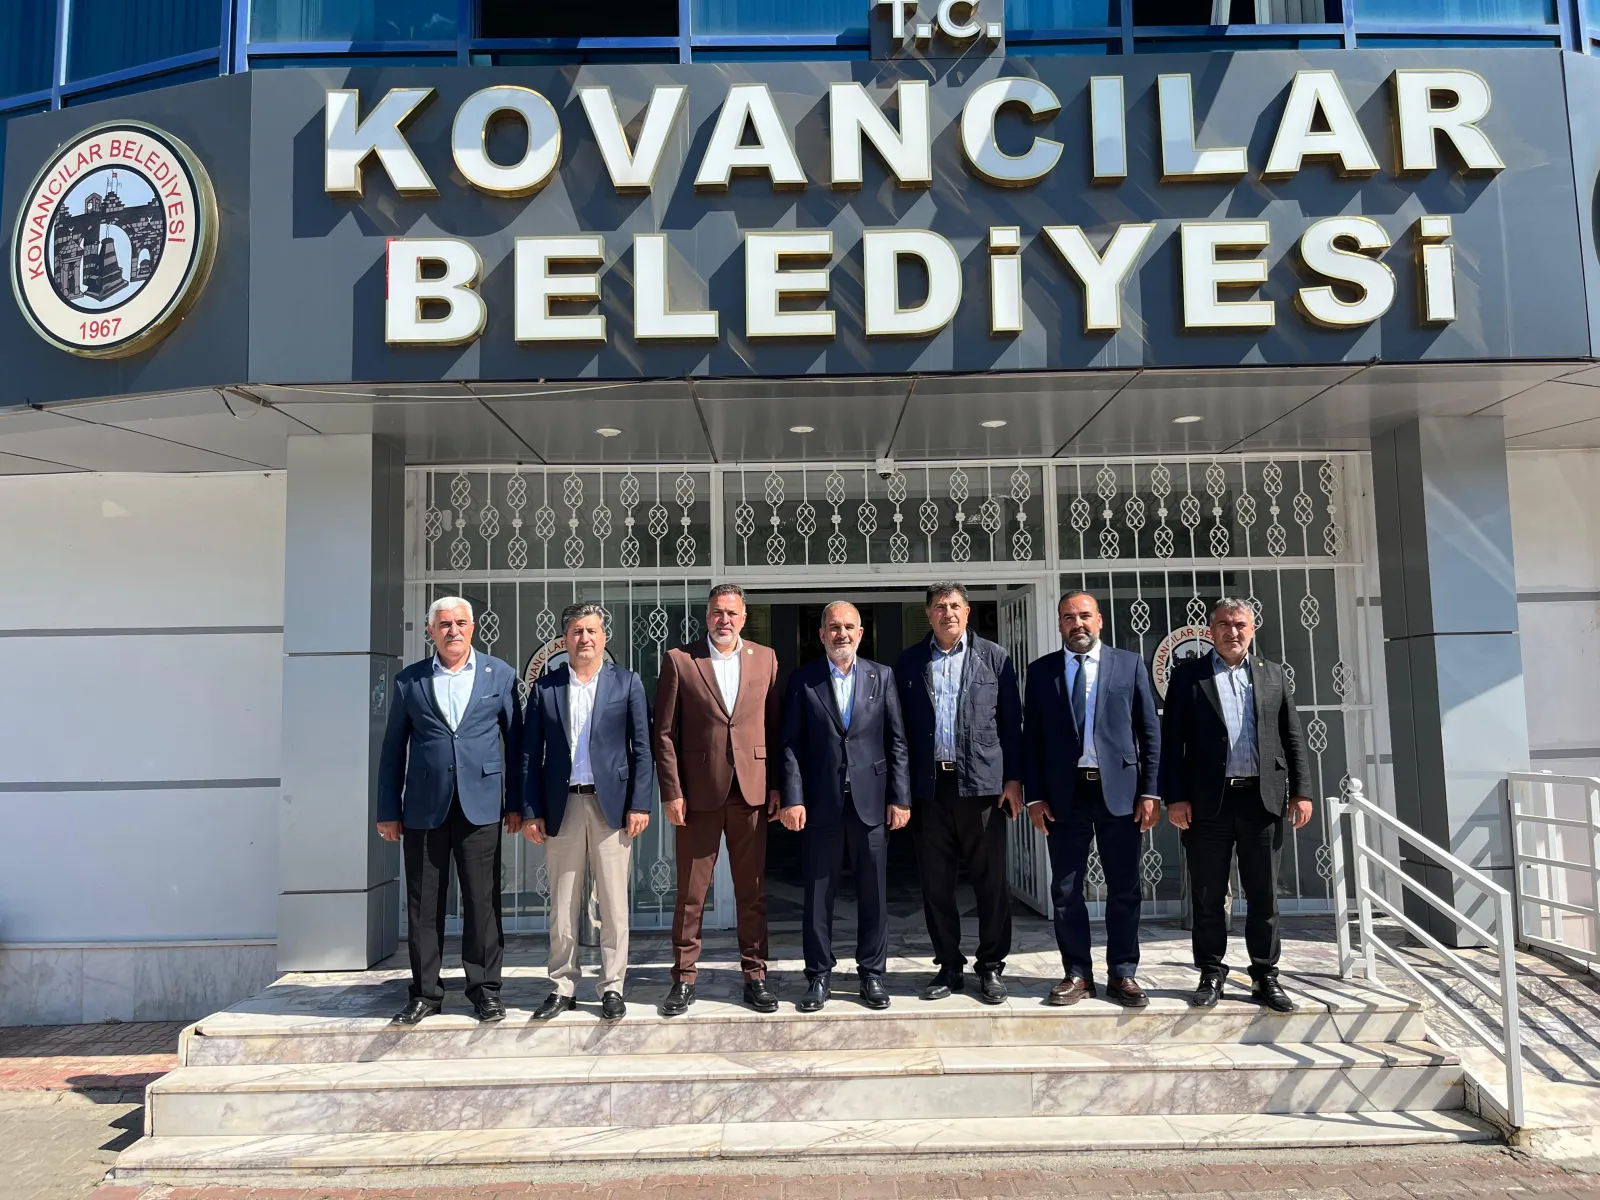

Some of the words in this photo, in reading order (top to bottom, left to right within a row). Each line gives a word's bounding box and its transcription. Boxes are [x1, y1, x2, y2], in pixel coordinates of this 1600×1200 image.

[877, 0, 1002, 42] T.C.
[325, 69, 1506, 197] KOVANCILAR
[27, 143, 103, 280] KOVANCILAR
[79, 317, 123, 340] 1967
